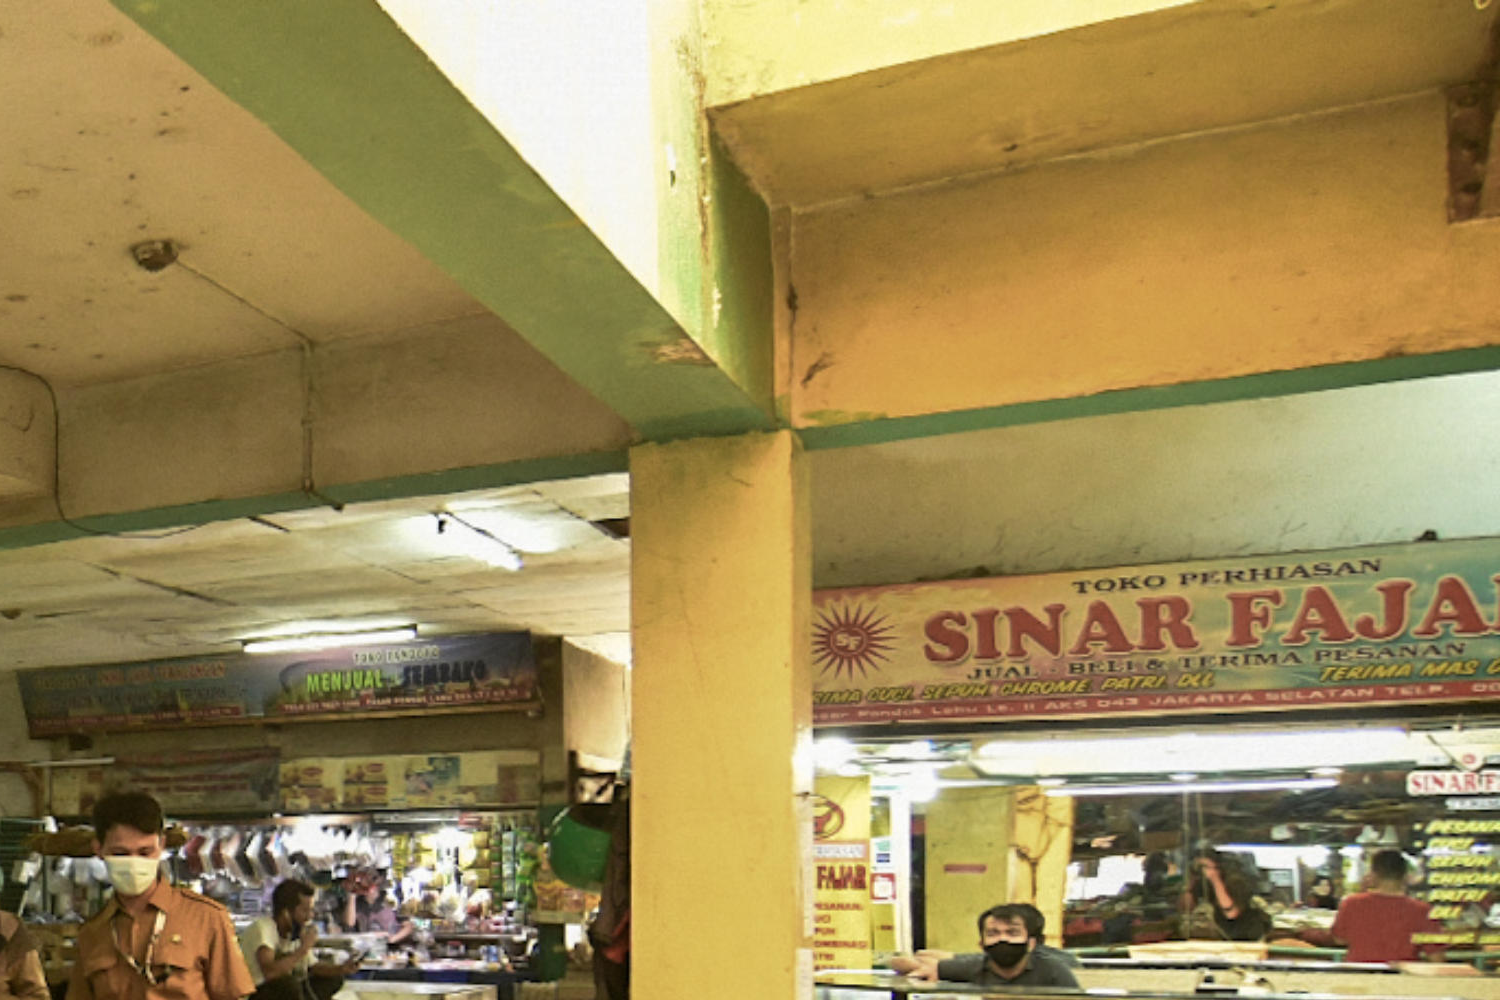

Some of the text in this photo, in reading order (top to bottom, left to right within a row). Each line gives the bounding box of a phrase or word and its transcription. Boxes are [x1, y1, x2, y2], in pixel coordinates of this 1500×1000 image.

[1072, 558, 1382, 594] TOKO PERHIASAN
[923, 594, 1200, 663] SINAR
[967, 664, 1039, 680] JUAL
[1068, 659, 1134, 675] BELI
[1146, 658, 1164, 671] &
[1179, 651, 1303, 669] TERIMA
[1315, 643, 1466, 663] PESANAN
[1319, 663, 1415, 682] TERIMA
[1419, 659, 1480, 677] MAS
[306, 669, 384, 693] MENJUAL
[1150, 692, 1254, 706] JAKARTA
[1265, 687, 1375, 701] SELATAN
[1411, 773, 1478, 793] SINAR
[816, 864, 867, 890] FAJAR
